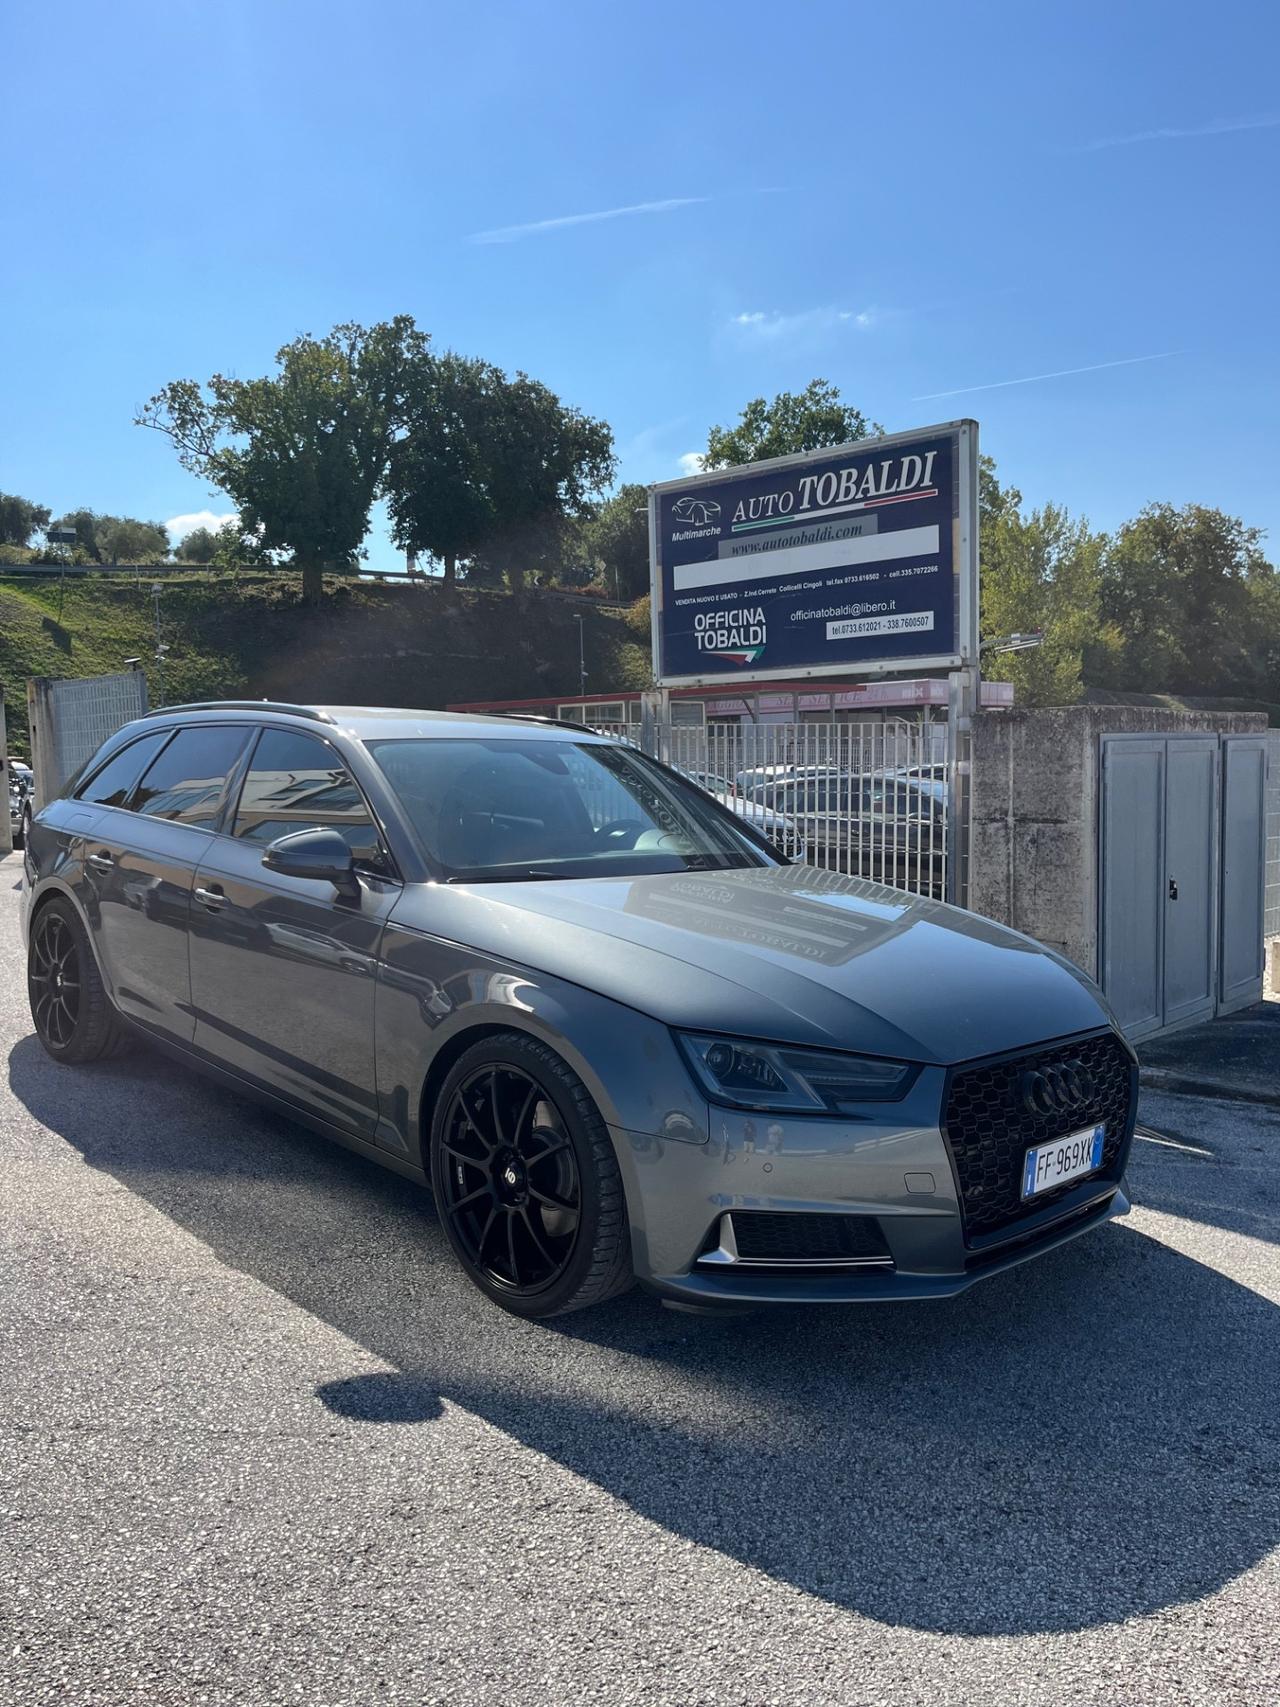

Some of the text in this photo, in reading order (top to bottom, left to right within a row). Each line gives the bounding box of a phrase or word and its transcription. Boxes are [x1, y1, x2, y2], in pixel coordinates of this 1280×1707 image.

[732, 451, 937, 522] AUTO TOBALDI
[672, 526, 721, 542] Multimarche
[731, 525, 862, 555] www.autotobaldi.com
[675, 597, 696, 606] VENDITA
[697, 595, 715, 603] NUOVO
[720, 592, 738, 600] USATO
[779, 582, 803, 592] Collicelli
[803, 580, 823, 590] Cingoli
[694, 607, 766, 630] OFFICINA
[790, 600, 896, 622] officinatobaldi@libero.it
[694, 625, 767, 650] TOBALDI
[832, 621, 881, 635] tel.0733.612021
